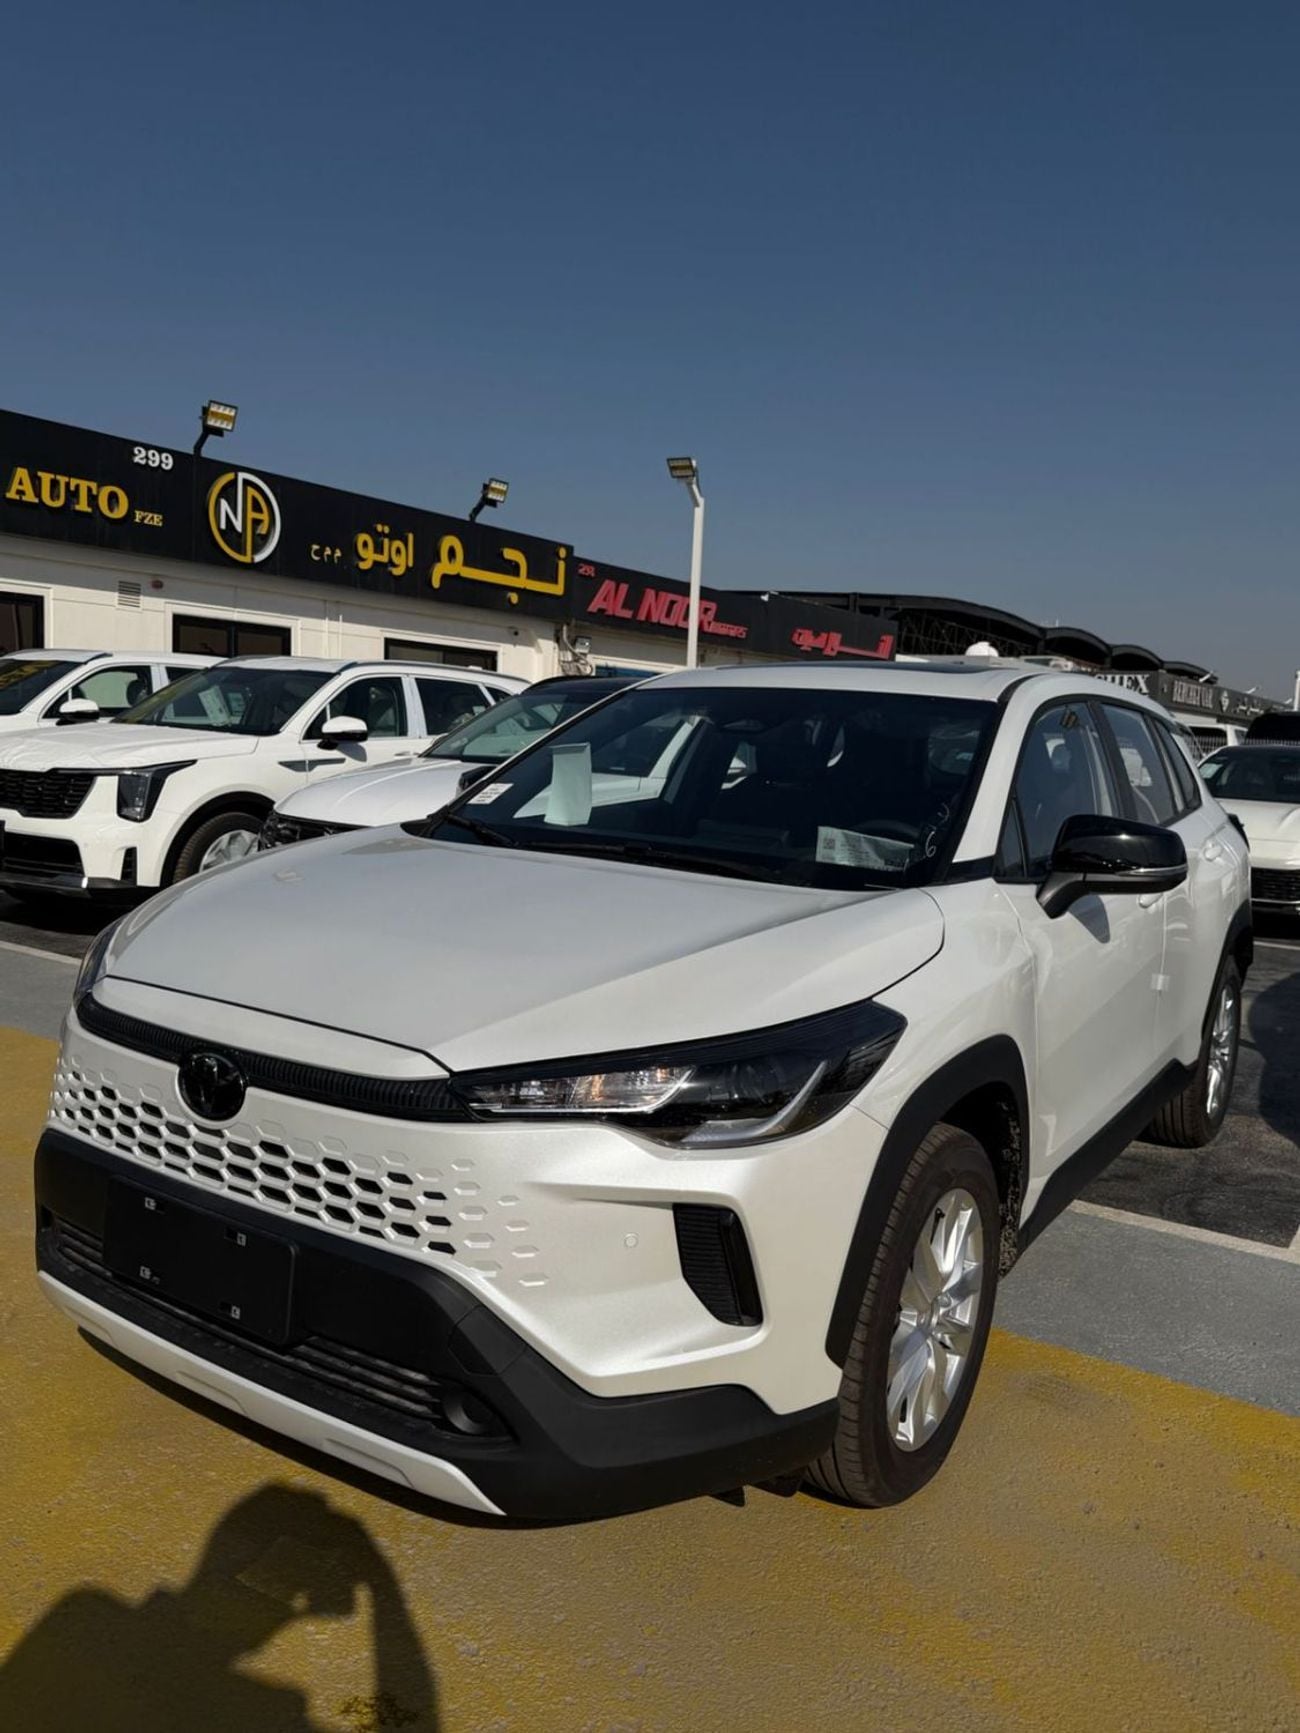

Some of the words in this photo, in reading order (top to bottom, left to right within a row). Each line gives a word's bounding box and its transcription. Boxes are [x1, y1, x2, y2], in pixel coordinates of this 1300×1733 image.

[132, 446, 174, 470] 299
[5, 467, 129, 519] AUTO
[134, 510, 163, 527] FZE
[355, 524, 414, 576] اوتو
[431, 535, 567, 604] نجم
[588, 579, 634, 619] AL
